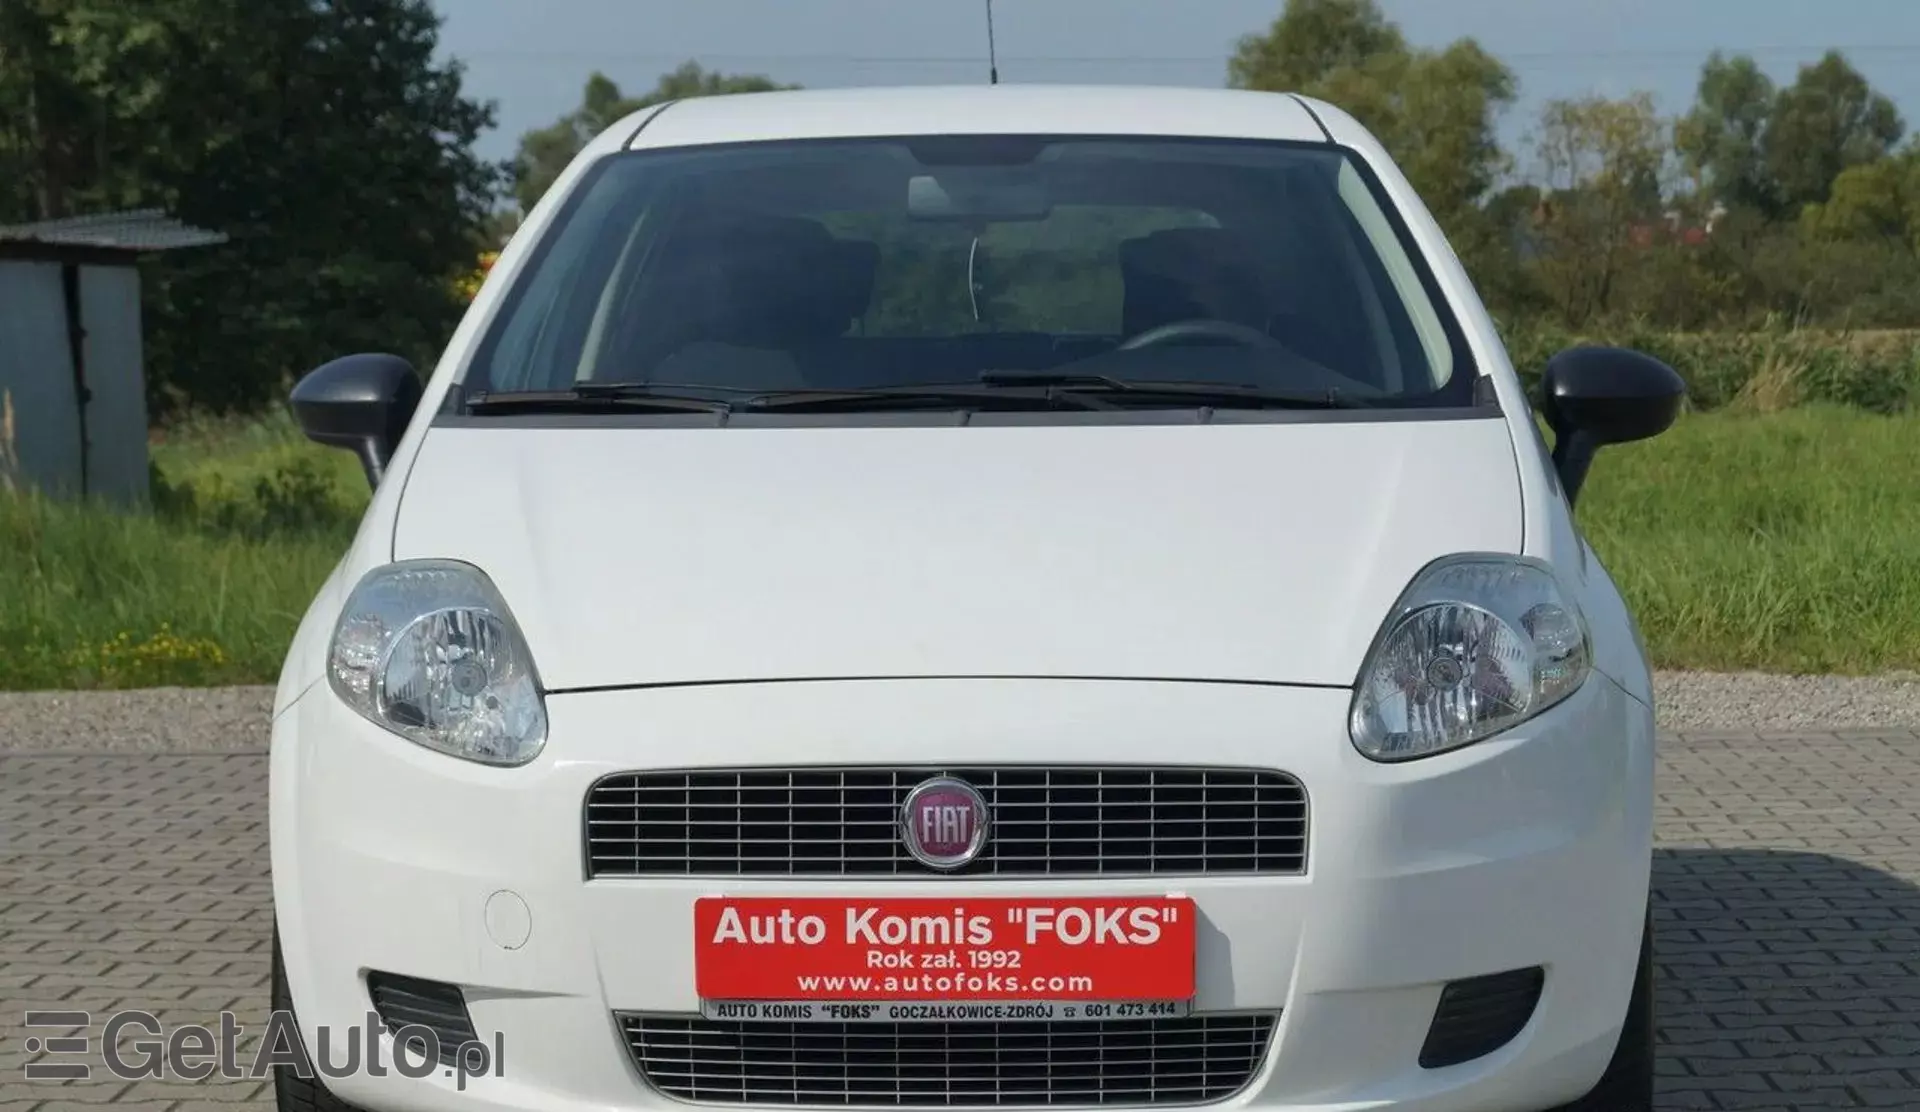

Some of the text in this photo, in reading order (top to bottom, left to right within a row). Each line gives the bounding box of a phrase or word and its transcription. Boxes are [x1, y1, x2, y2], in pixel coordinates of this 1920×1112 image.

[922, 806, 970, 843] FIAT
[713, 907, 1177, 945] Auto Komis "FOKS"
[867, 950, 1021, 968] Rok zał. 1992
[798, 972, 1093, 992] www.autofoks.com
[717, 1004, 758, 1019] AUTO
[763, 1003, 812, 1019] KOMIS
[889, 1002, 1054, 1020] GOCZAŁKOWICE-ZDRÓJ
[1085, 1004, 1113, 1017] 601
[1117, 1003, 1145, 1017] 473
[1148, 1002, 1176, 1016] 414
